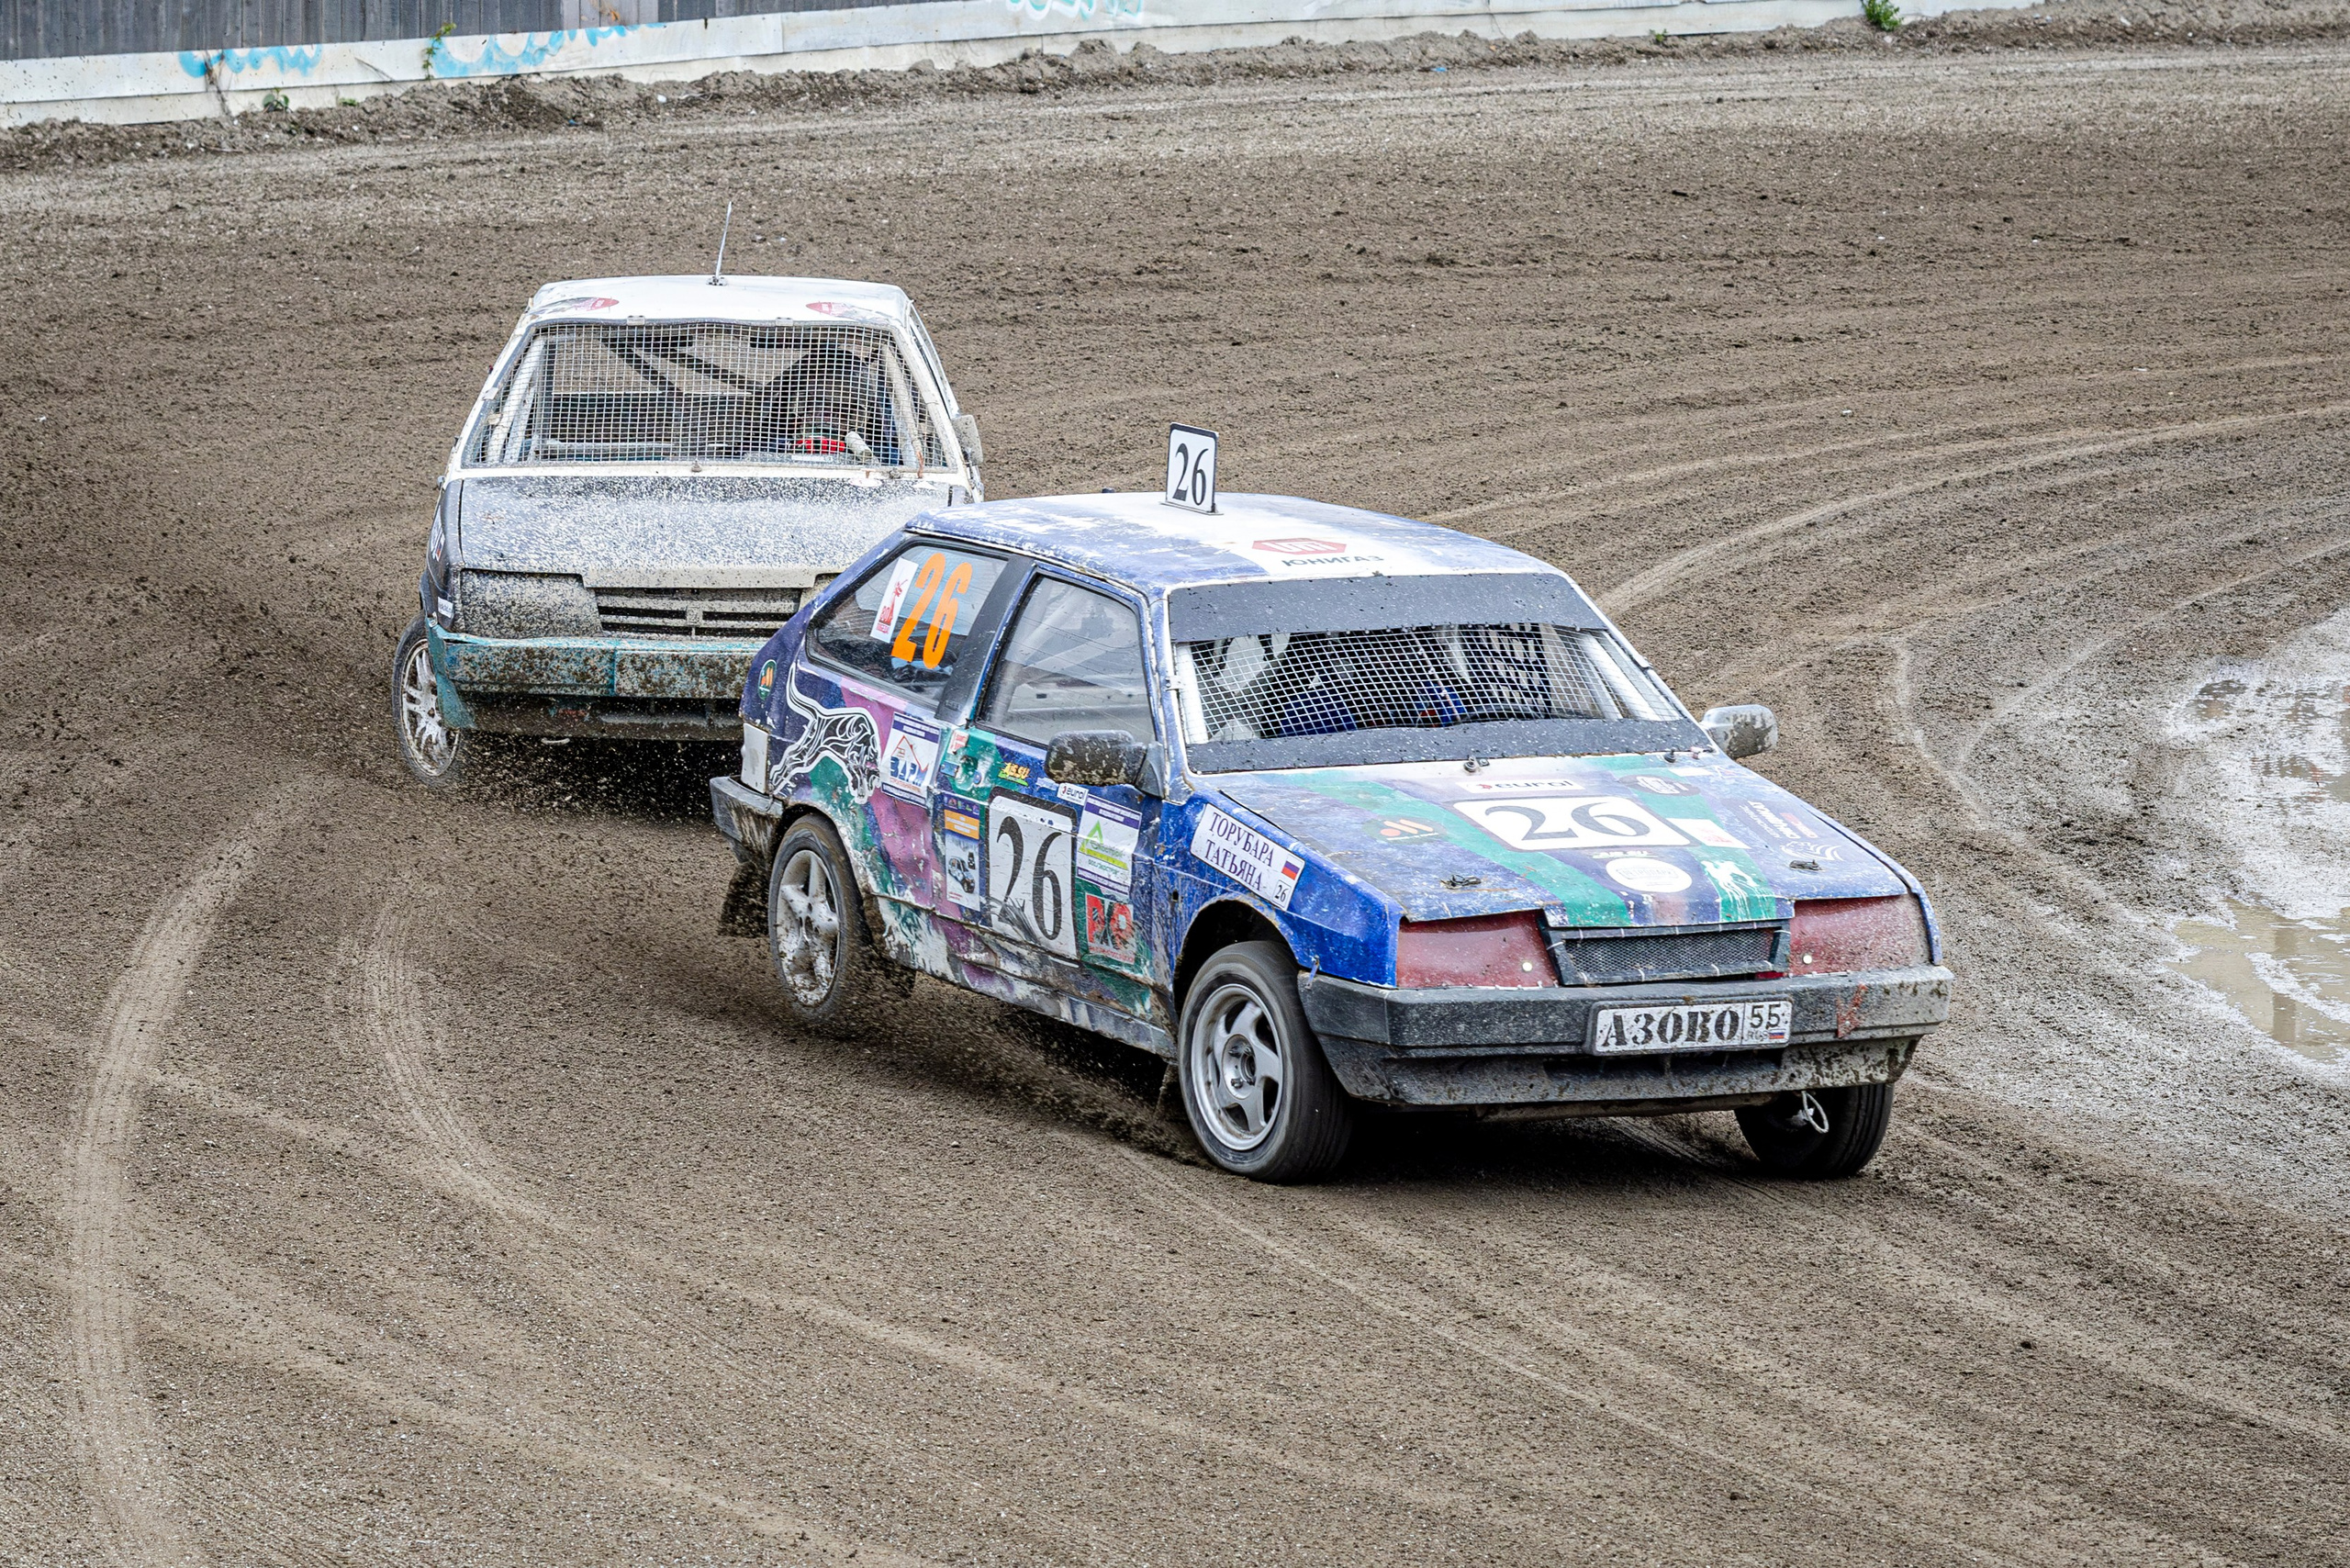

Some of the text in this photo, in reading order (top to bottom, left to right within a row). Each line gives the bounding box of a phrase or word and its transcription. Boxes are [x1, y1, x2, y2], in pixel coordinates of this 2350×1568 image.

[1171, 442, 1209, 506] 26
[1281, 554, 1384, 566] ЮНИГАЗ
[891, 553, 973, 669] 26
[1209, 812, 1275, 868] ТОРУБАРА
[1484, 801, 1651, 841] 26
[994, 815, 1062, 940] 26
[1204, 839, 1263, 891] ТАТЬЯНА
[1274, 884, 1289, 902] 26
[1749, 1003, 1782, 1030] 55
